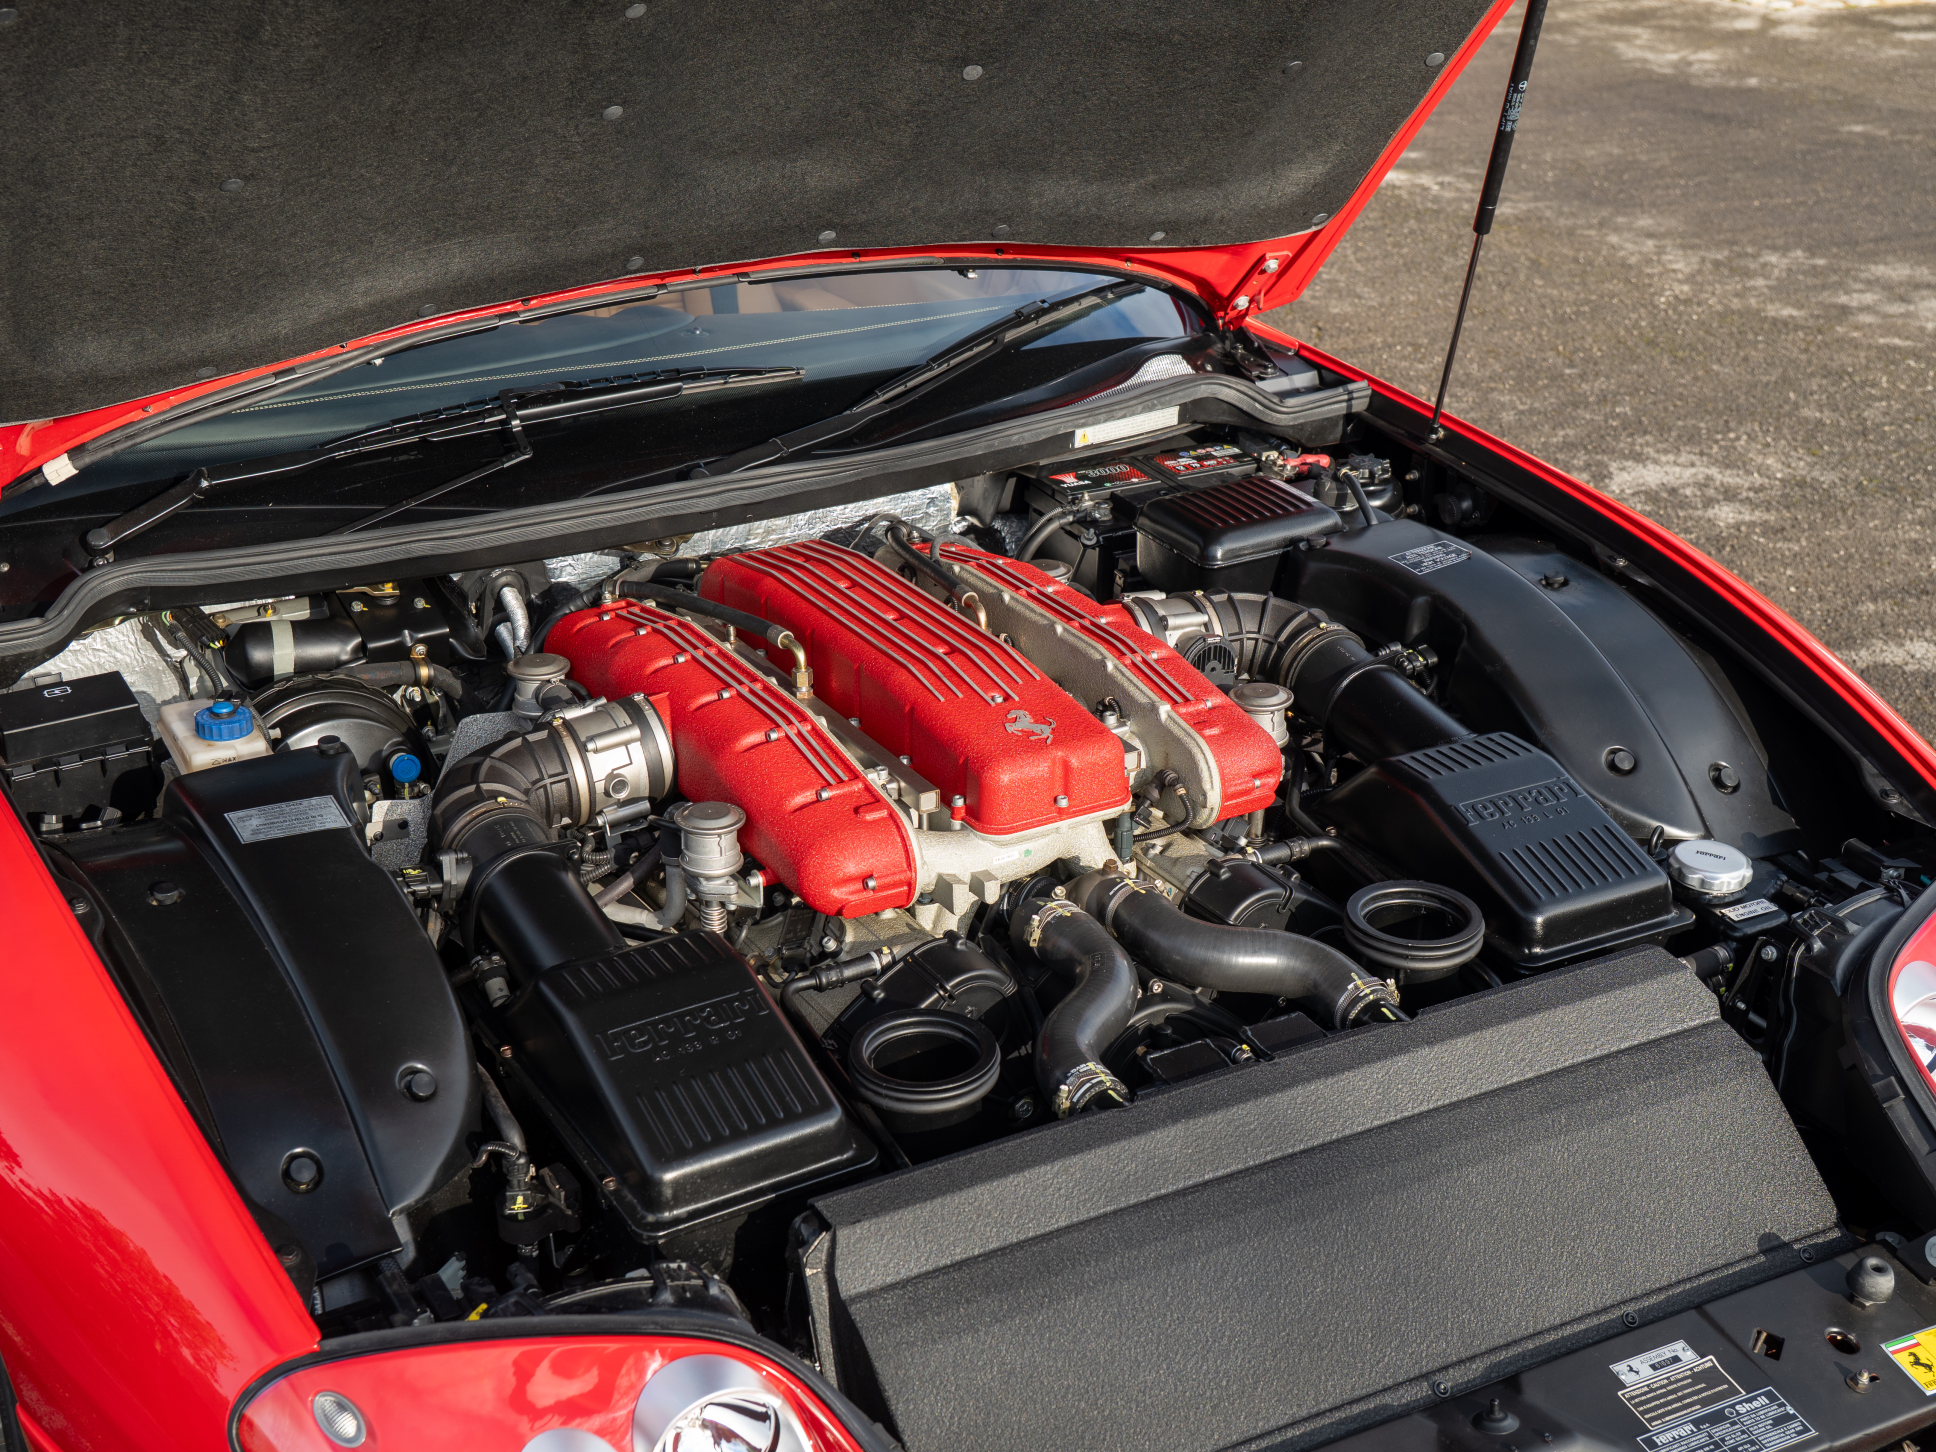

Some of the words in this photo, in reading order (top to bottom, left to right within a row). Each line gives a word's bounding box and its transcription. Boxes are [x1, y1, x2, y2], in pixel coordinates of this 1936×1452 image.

[1060, 480, 1092, 488] YUASA
[1452, 776, 1586, 827] Ferrari
[1735, 909, 1759, 919] ENGINE
[596, 988, 770, 1061] Ferrari
[1640, 1352, 1667, 1365] ASSEMBLY
[1734, 1395, 1770, 1414] Shell
[1652, 1422, 1698, 1446] Ferrari
